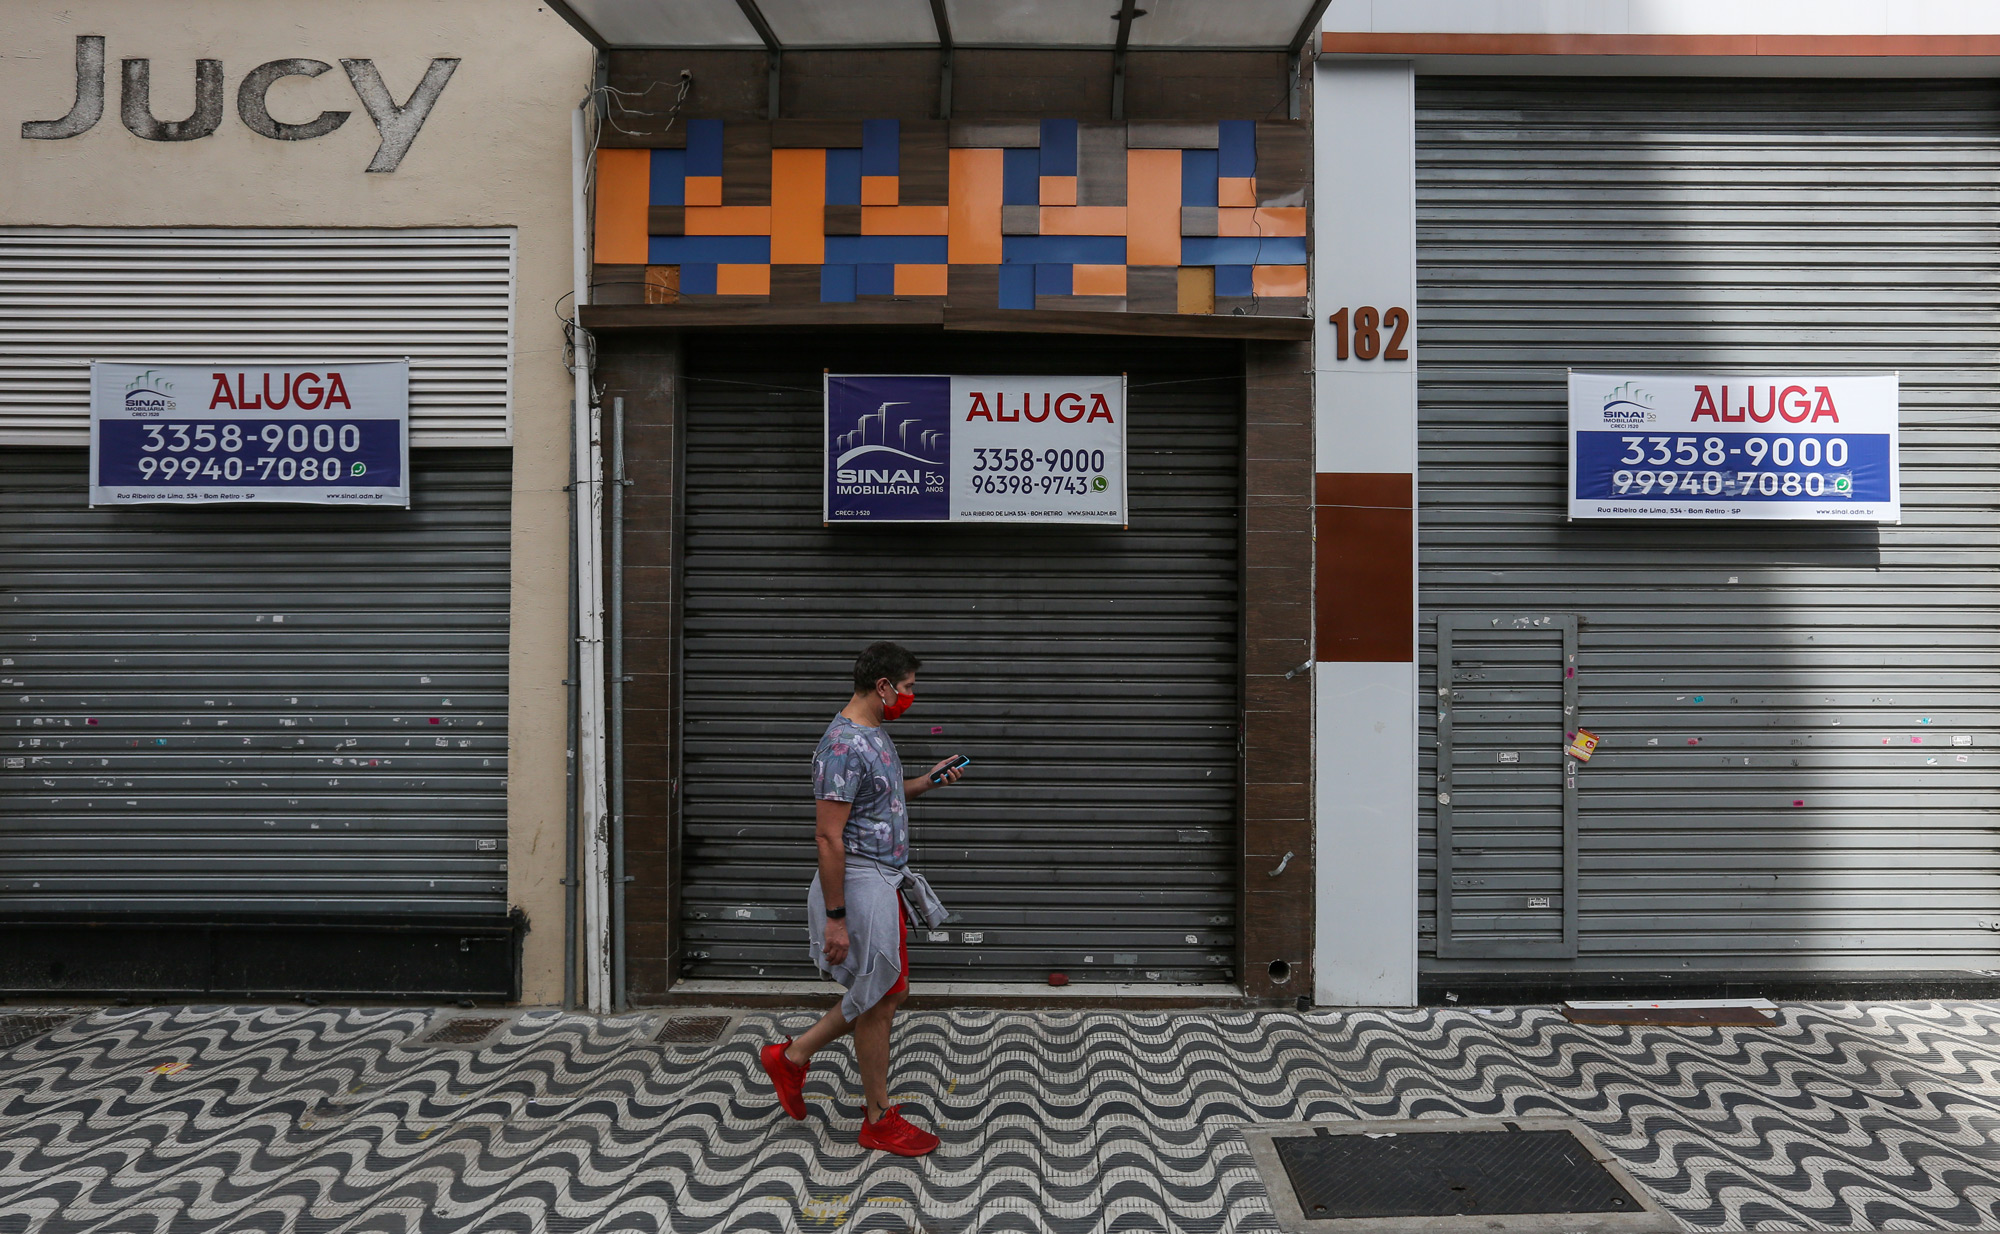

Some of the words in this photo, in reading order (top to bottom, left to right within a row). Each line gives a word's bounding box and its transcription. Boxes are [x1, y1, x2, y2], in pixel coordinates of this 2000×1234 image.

[1329, 306, 1409, 360] 182
[209, 372, 351, 409] ALUGA
[1691, 385, 1839, 423] ALUGA
[966, 392, 1114, 423] ALUGA
[141, 424, 360, 452] 3358-9000
[1620, 436, 1848, 466] 3358-9000
[138, 457, 341, 481] 99940-7080
[973, 448, 1104, 472] 3358-9000
[836, 484, 919, 494] IMOBILIÁRIA
[837, 470, 920, 484] SINAI
[925, 472, 944, 486] 50
[972, 475, 1088, 495] 96398-9743
[1613, 470, 1824, 496] 99940-7080
